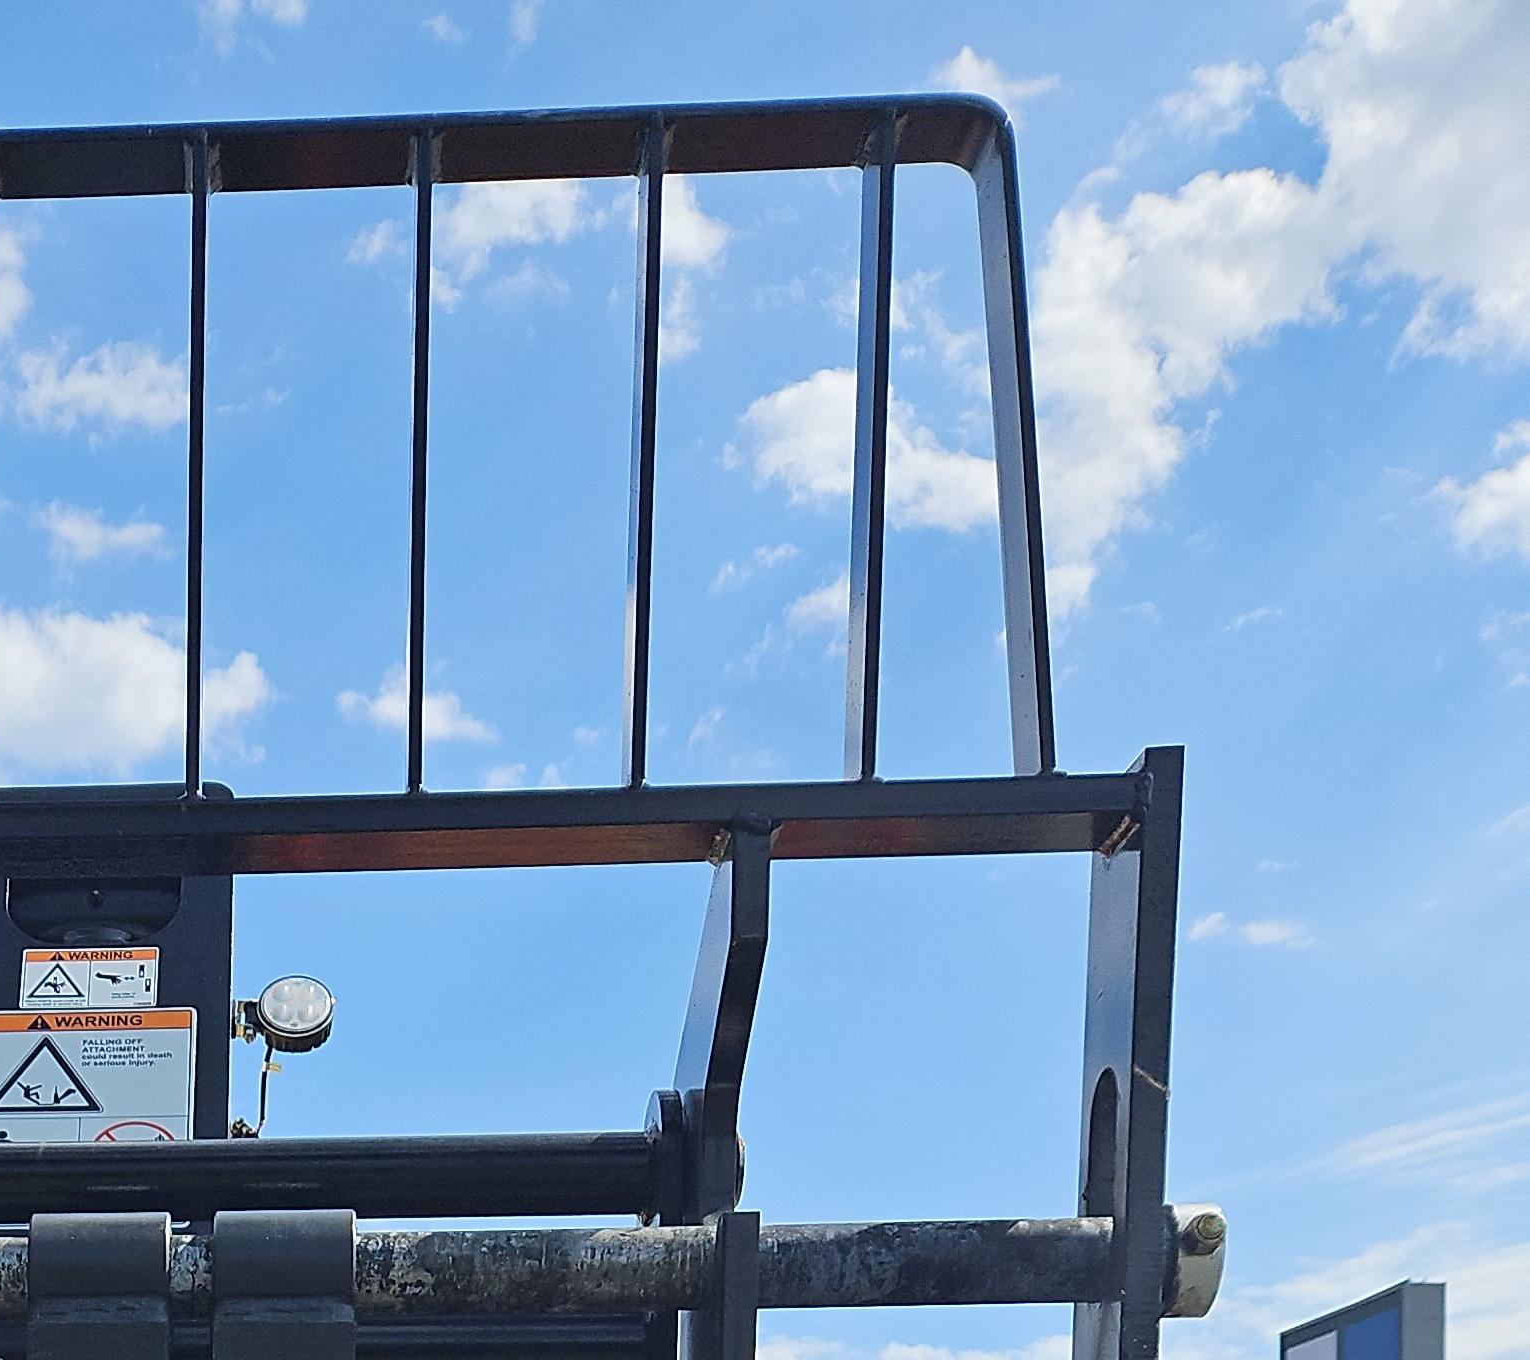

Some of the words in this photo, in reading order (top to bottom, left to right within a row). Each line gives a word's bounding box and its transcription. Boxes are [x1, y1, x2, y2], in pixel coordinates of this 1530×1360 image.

[68, 950, 134, 960] WARNING
[54, 1015, 144, 1028] WARNING
[82, 1038, 122, 1046] FALLING
[82, 1045, 146, 1053] ATTACHMENT
[81, 1053, 108, 1061] could
[109, 1052, 135, 1060] result
[137, 1052, 146, 1060] in
[147, 1051, 173, 1059] death
[93, 1059, 127, 1067] serious
